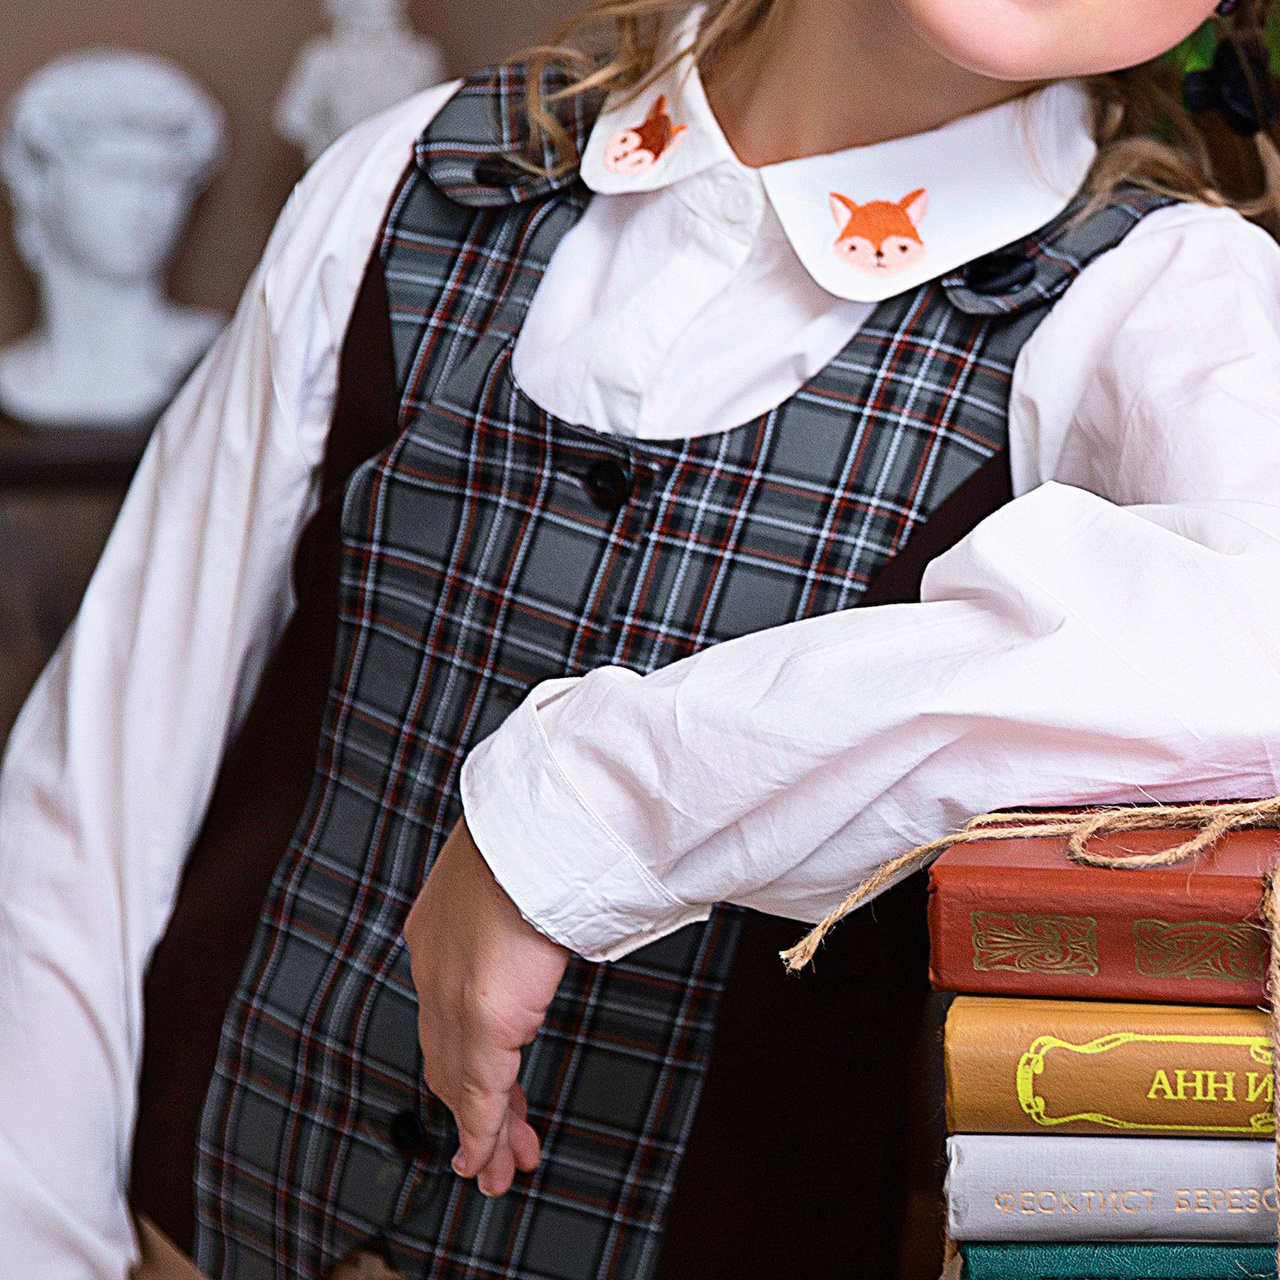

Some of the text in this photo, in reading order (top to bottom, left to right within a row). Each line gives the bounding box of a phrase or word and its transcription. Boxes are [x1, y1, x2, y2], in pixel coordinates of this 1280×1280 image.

[1147, 1070, 1236, 1102] АНН
[1246, 1072, 1277, 1104] И
[994, 1188, 1157, 1215] ФЕОКТИСТ
